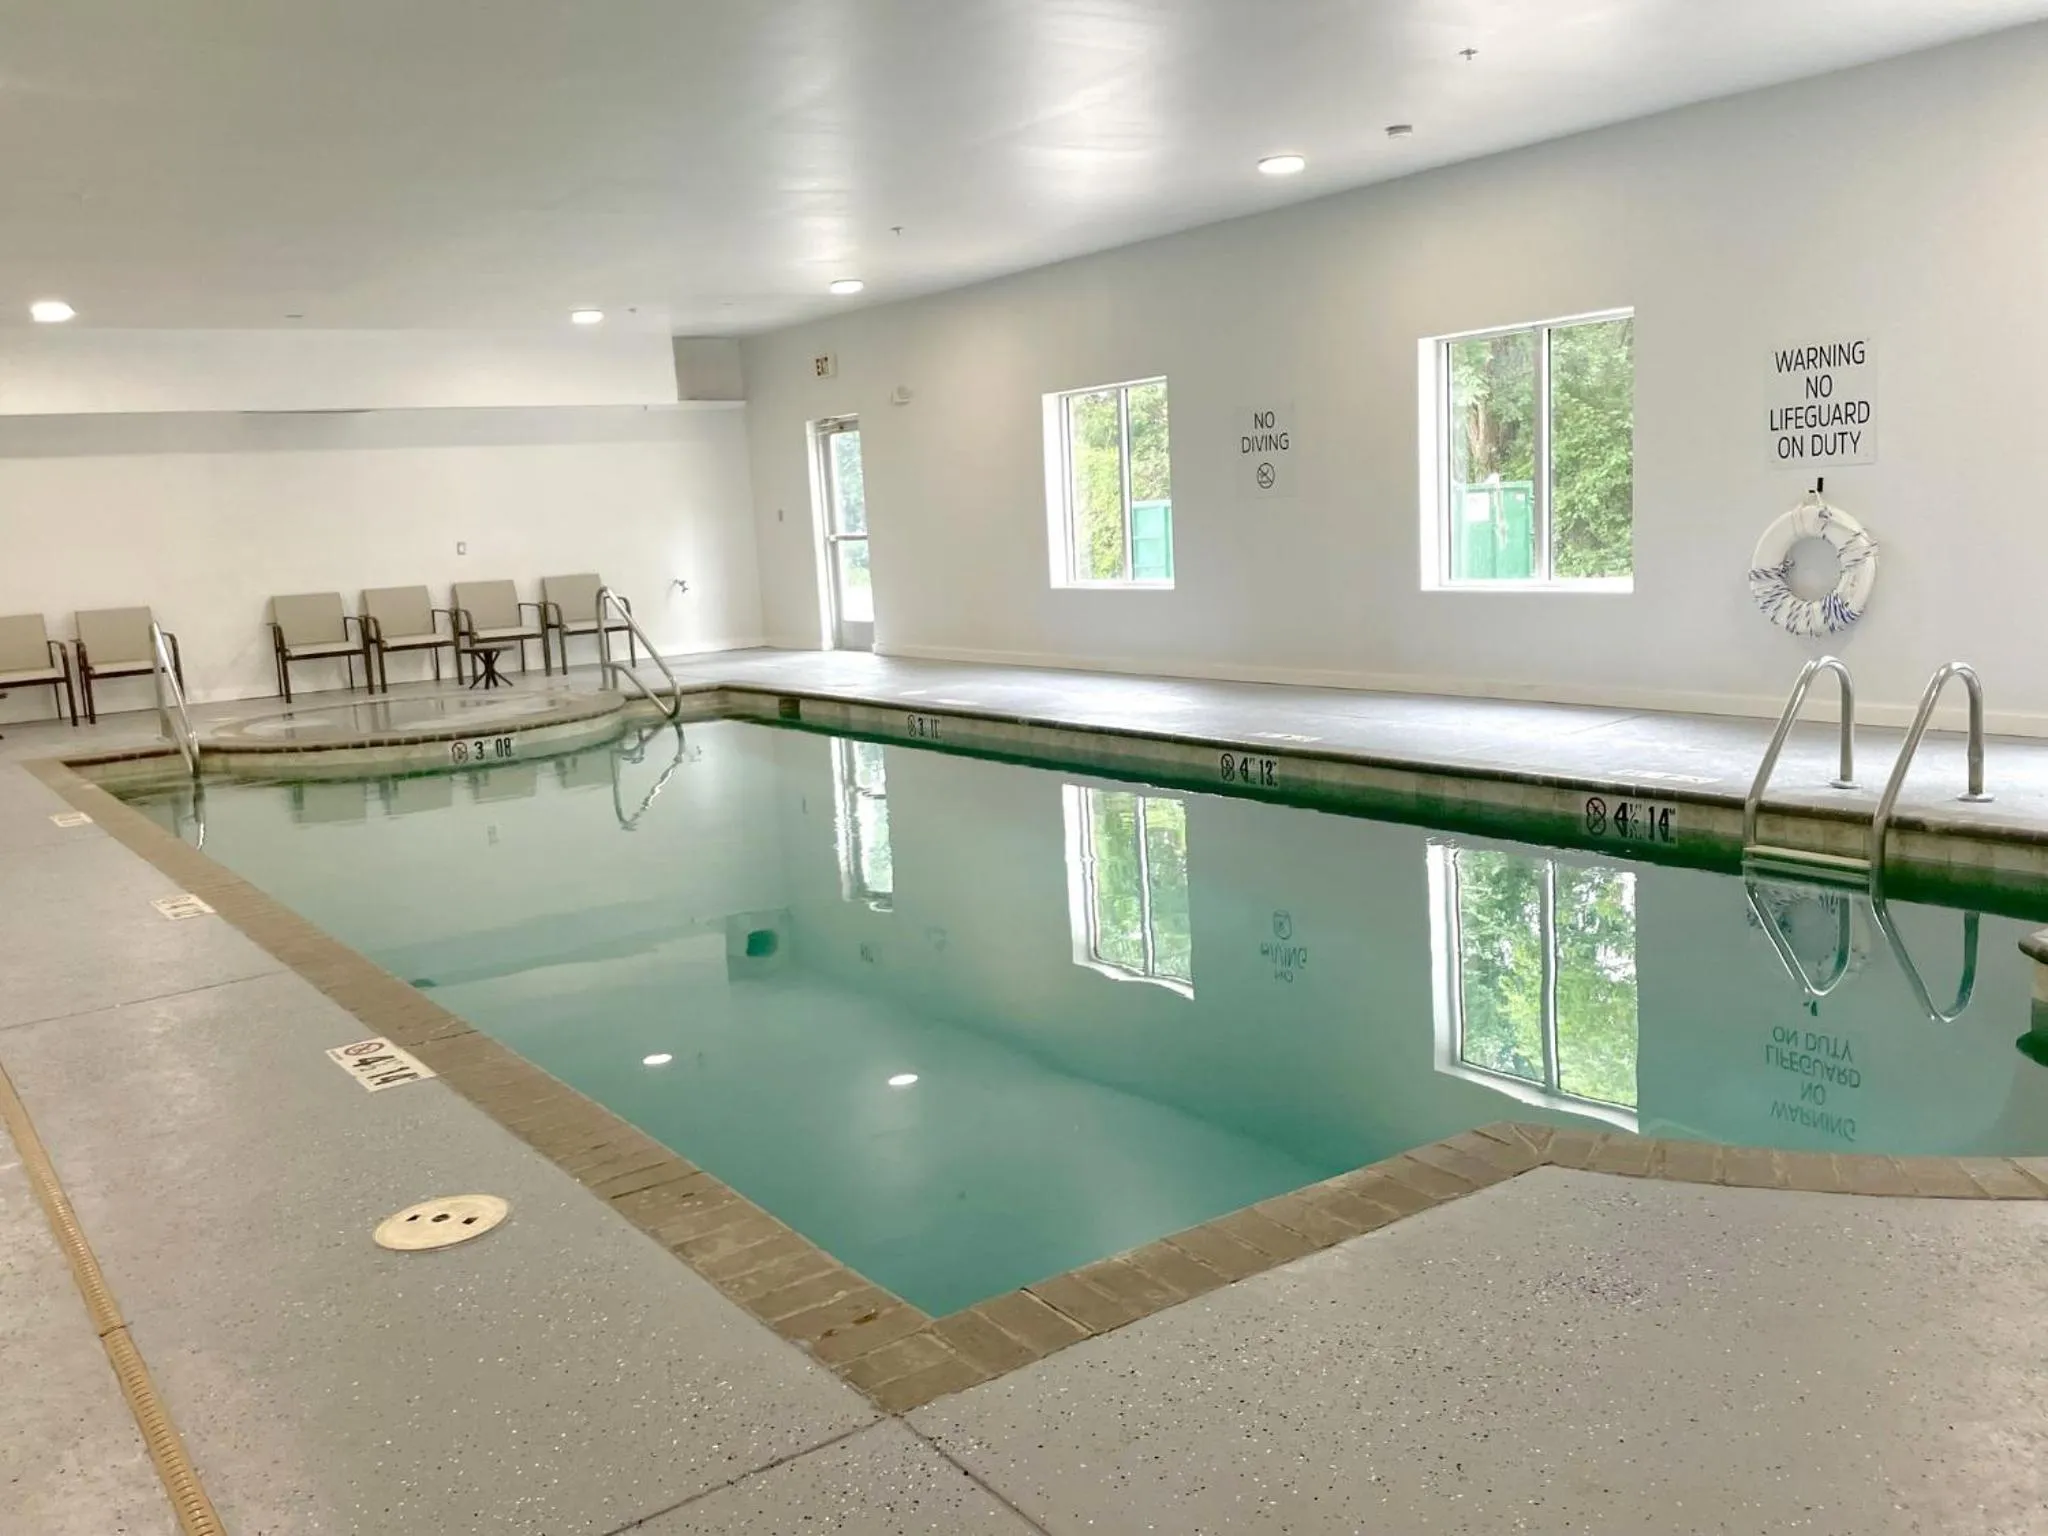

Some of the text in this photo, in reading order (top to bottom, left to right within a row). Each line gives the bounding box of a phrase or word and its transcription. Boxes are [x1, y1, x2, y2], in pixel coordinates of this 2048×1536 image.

[1774, 340, 1866, 373] WARNING
[1805, 374, 1833, 399] NO
[1253, 410, 1275, 429] NO
[1770, 400, 1870, 431] LIFEGUARD
[1241, 432, 1290, 454] DIVING
[1777, 430, 1862, 459] ON DUTY
